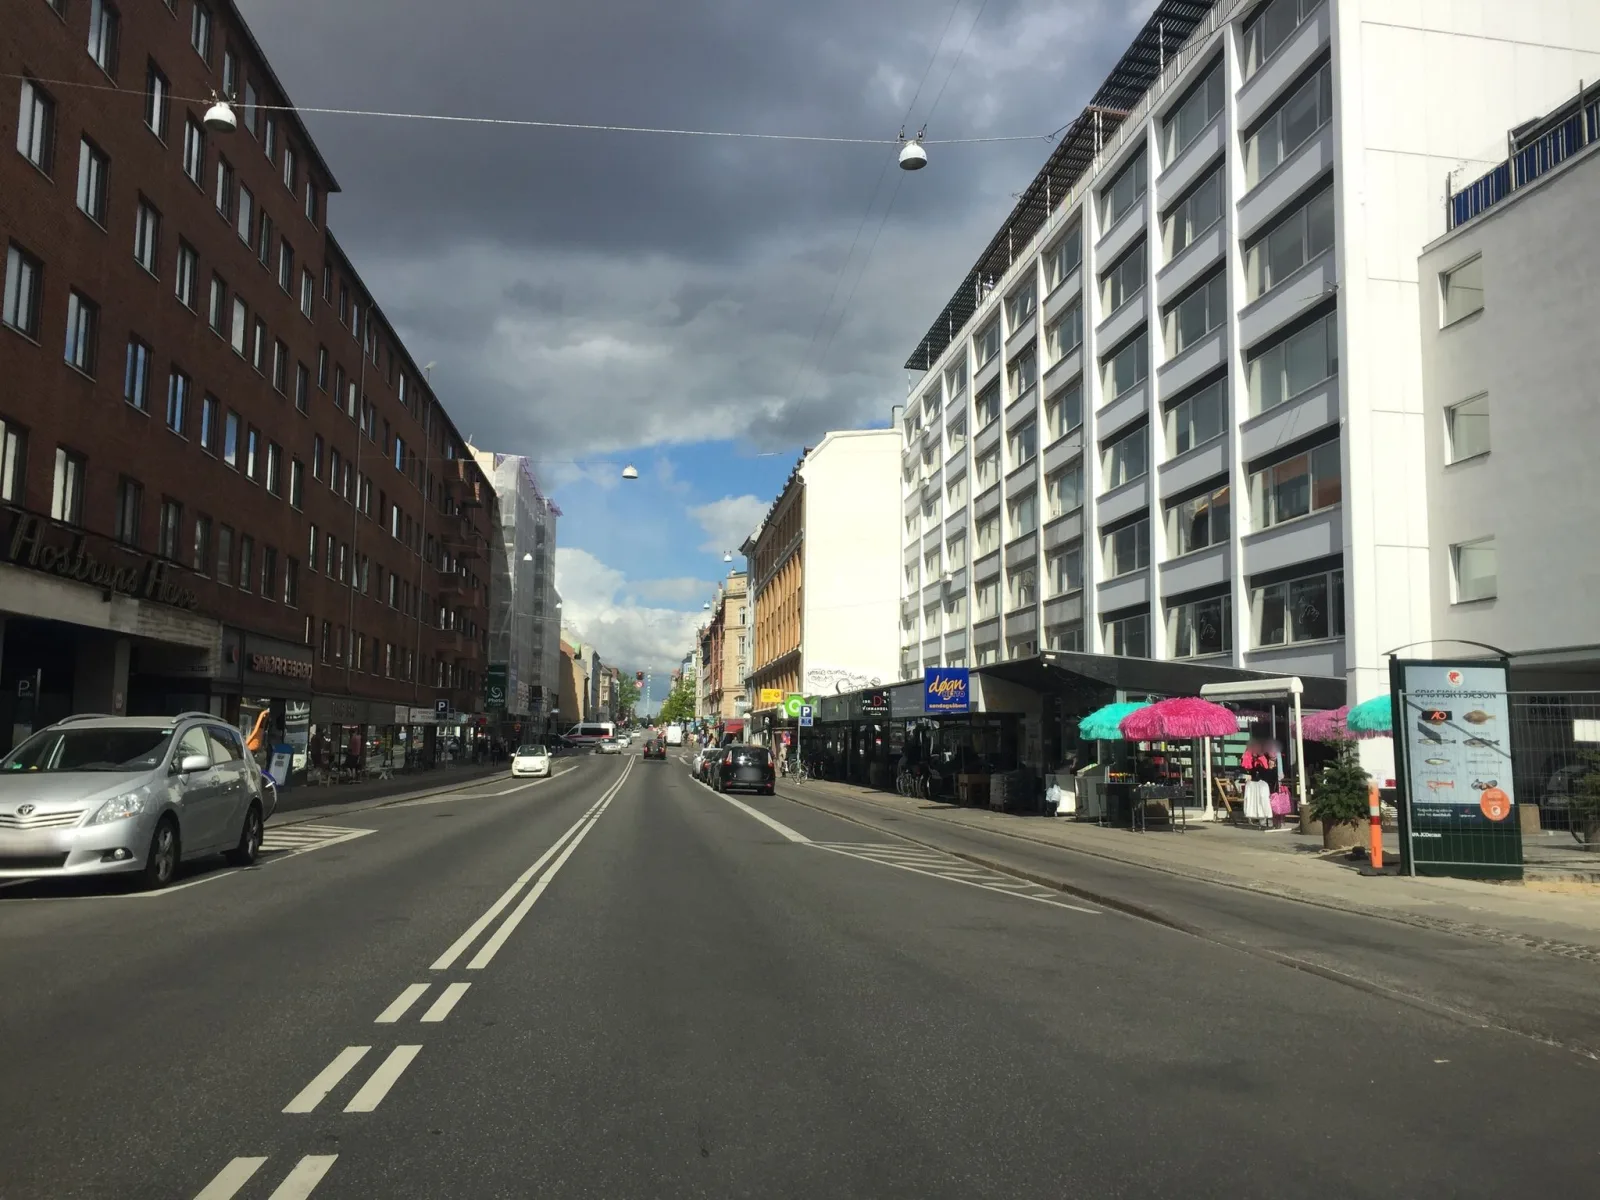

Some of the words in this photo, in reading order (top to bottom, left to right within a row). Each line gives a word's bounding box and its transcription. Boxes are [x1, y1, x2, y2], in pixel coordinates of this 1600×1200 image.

[9, 513, 138, 592] Hostrups
[928, 674, 967, 700] døgn
[438, 701, 446, 712] P
[802, 706, 811, 717] P
